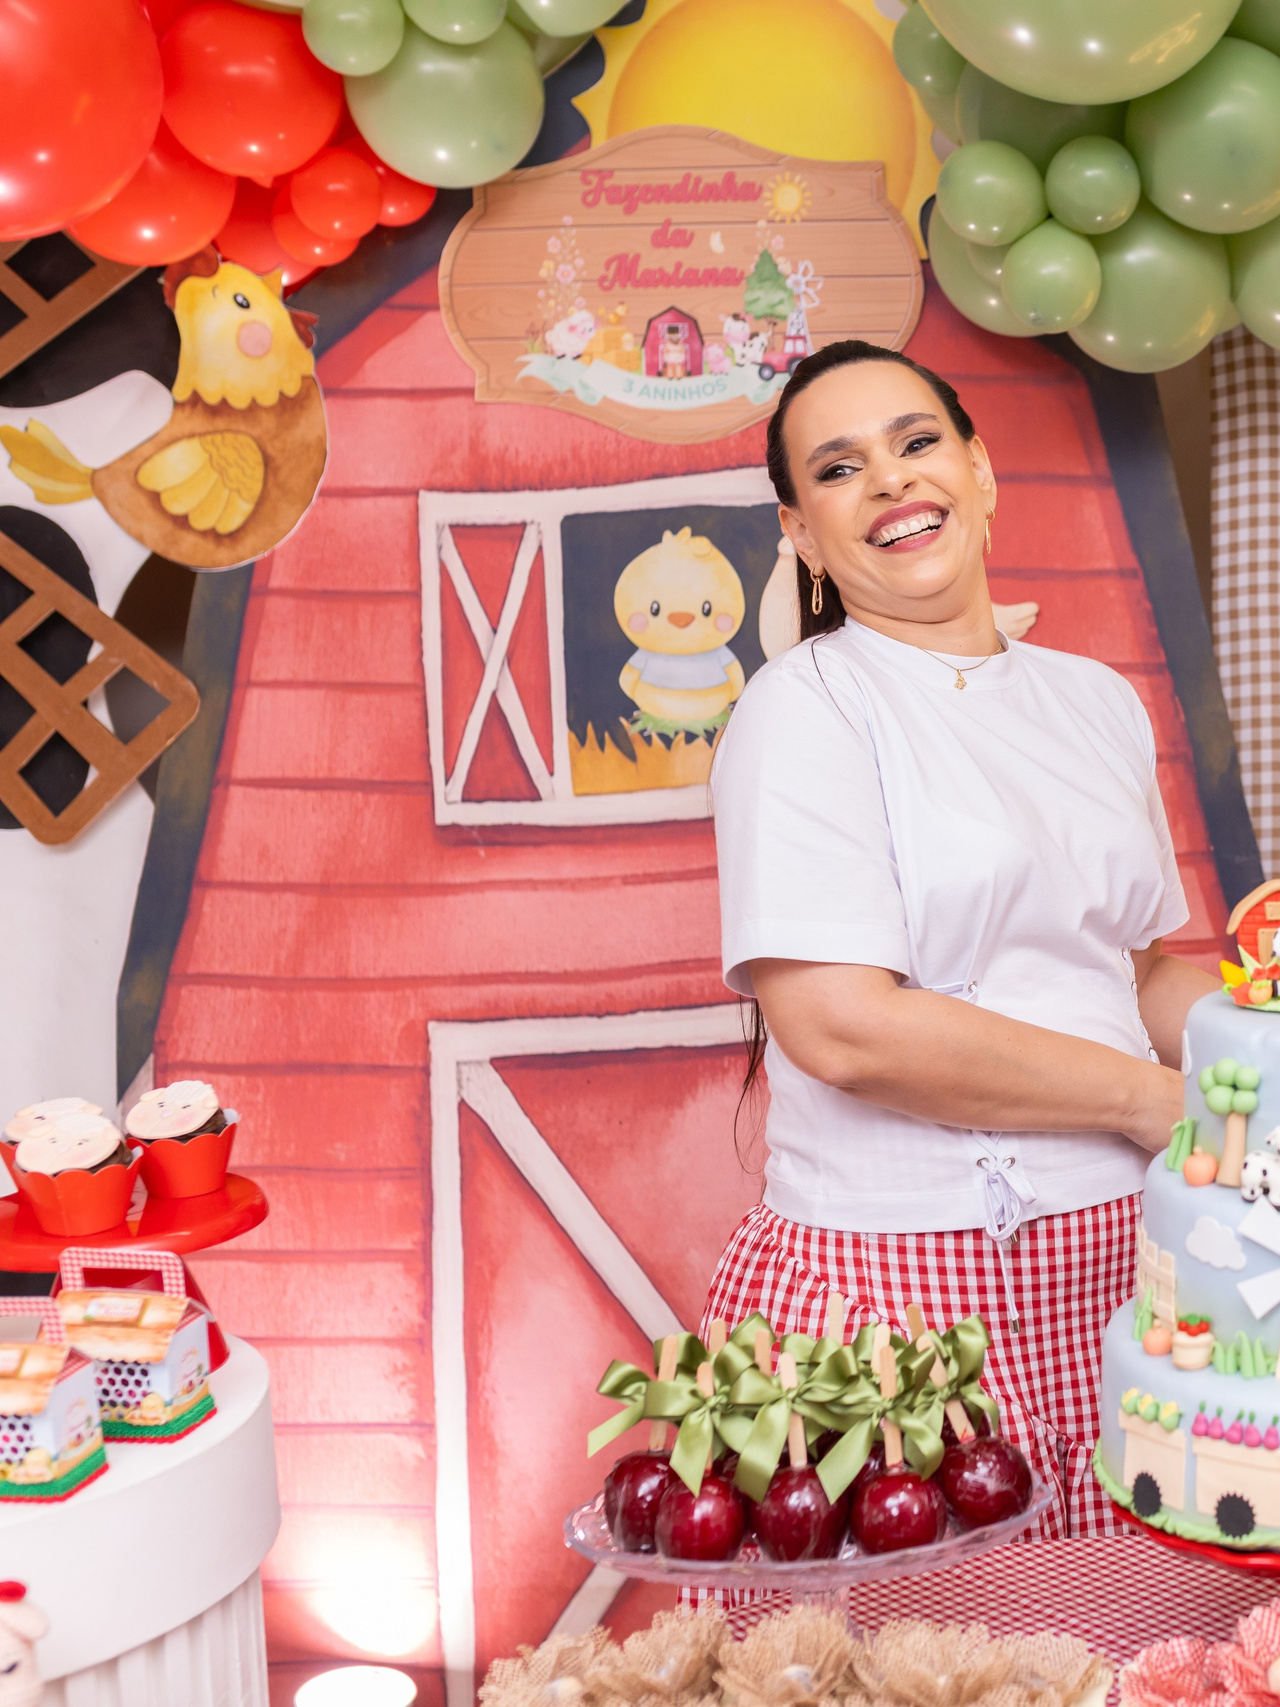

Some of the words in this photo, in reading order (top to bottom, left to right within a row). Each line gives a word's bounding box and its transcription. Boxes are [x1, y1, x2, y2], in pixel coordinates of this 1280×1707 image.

[581, 170, 763, 215] Fazendinha
[651, 218, 695, 249] da
[598, 252, 745, 291] Mariana
[623, 378, 634, 393] 3
[637, 378, 727, 400] ANINHOS
